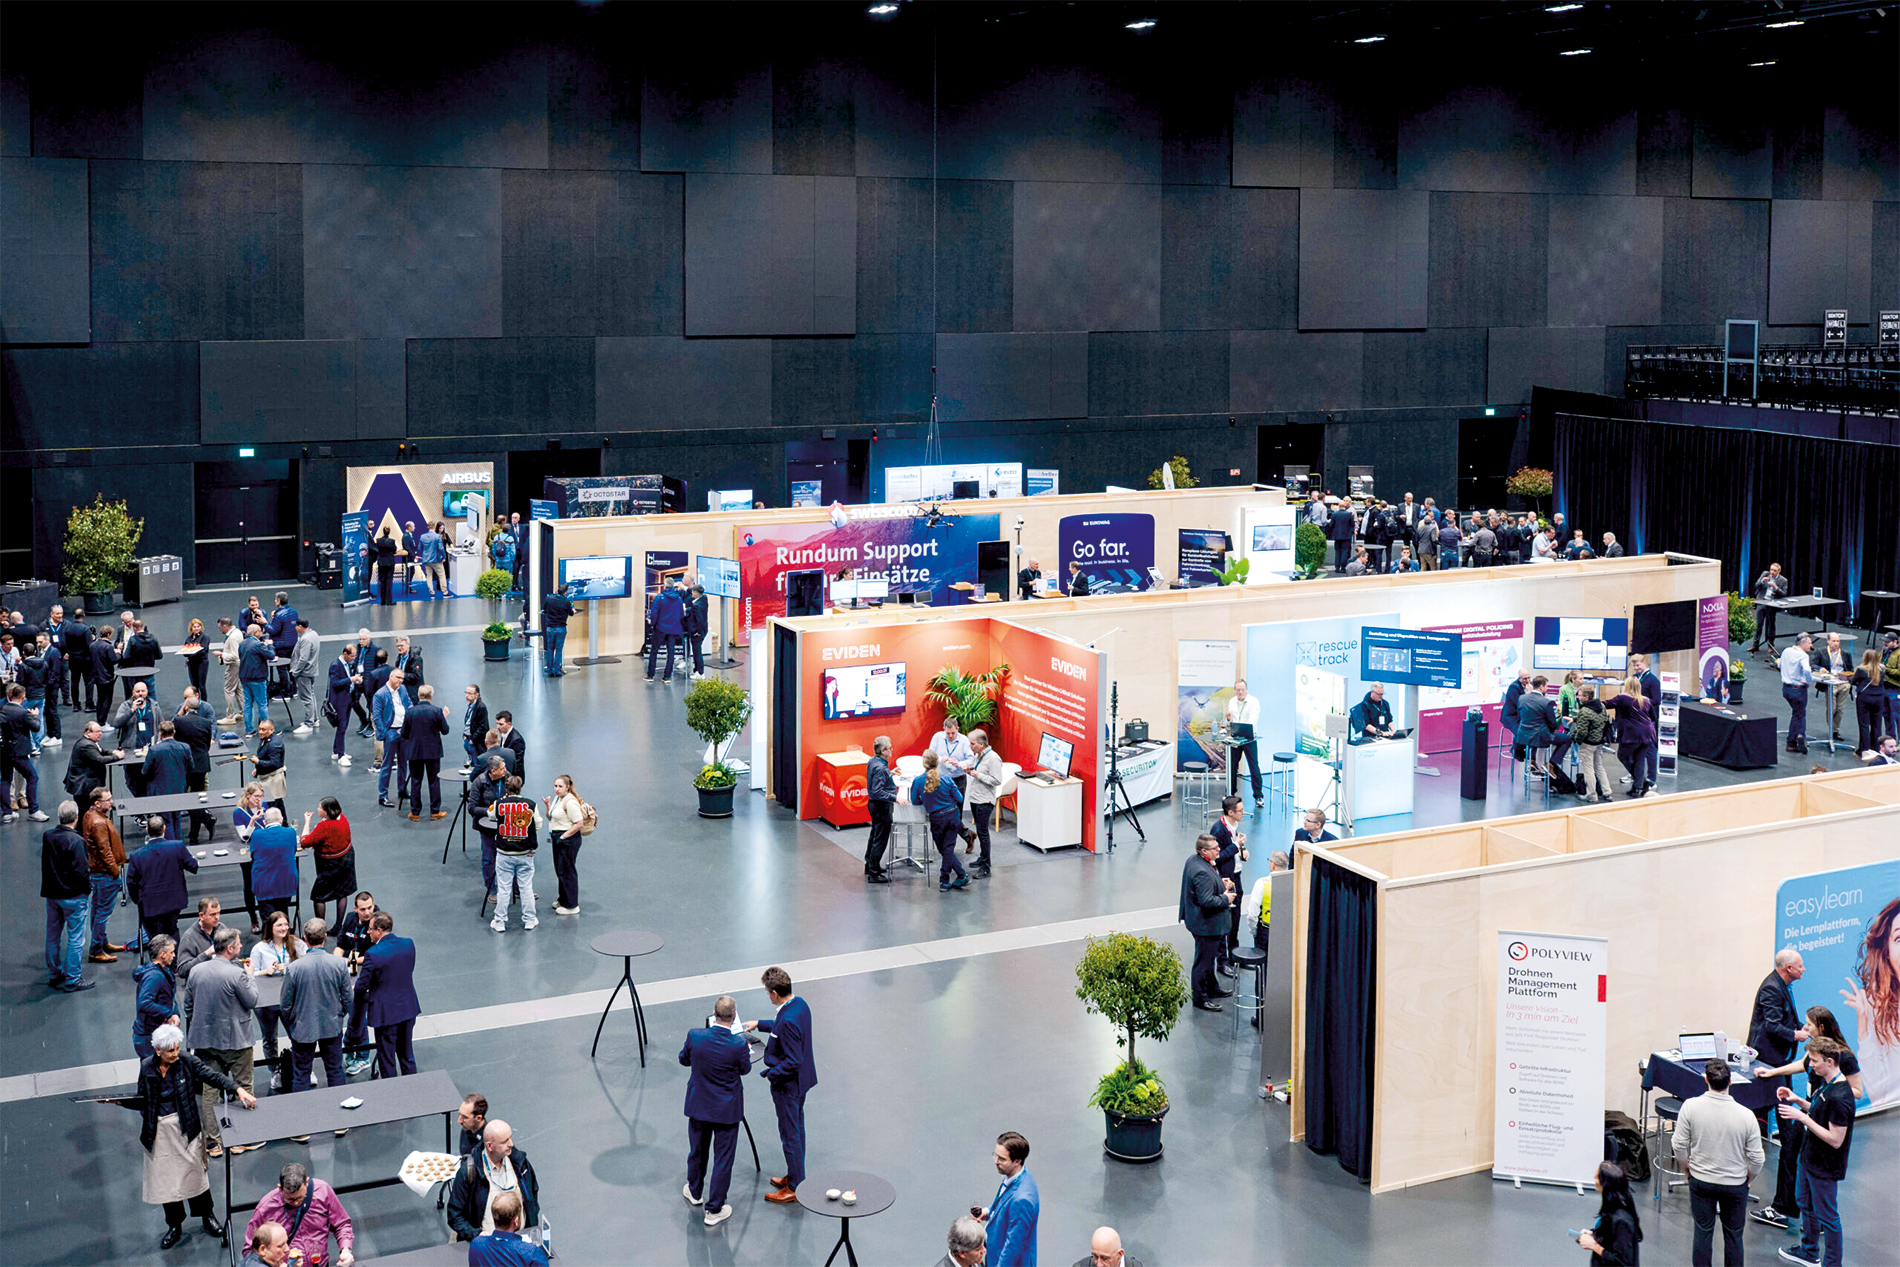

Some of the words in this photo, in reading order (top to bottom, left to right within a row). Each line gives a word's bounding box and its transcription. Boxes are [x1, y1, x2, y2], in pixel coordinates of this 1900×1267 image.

[441, 472, 491, 484] AIRBUS
[850, 503, 918, 519] swisscom
[776, 543, 857, 565] Rundum
[864, 539, 938, 564] Support
[1073, 540, 1095, 558] Go
[1099, 538, 1129, 556] far.
[854, 565, 929, 584] Einsätze
[1703, 603, 1724, 613] NOKIA
[744, 597, 752, 639] swisscom
[822, 644, 880, 660] EVIDEN
[1319, 640, 1357, 652] rescue
[1318, 652, 1348, 666] track
[1051, 657, 1086, 681] EVIDEN
[1122, 759, 1157, 777] SECURITON
[841, 789, 868, 798] EVIDE
[499, 803, 529, 815] CHAOS
[1786, 885, 1862, 919] easylearn
[1785, 927, 1799, 939] Die
[1801, 918, 1861, 935] Lernplattform,
[1785, 941, 1798, 951] die
[1799, 933, 1844, 951] begeistert!
[1532, 948, 1592, 961] POLYVIEW
[1508, 967, 1553, 978] Drohnen
[1508, 977, 1577, 990] Management
[1508, 987, 1557, 998] Plattform
[1506, 1003, 1533, 1011] Unsere
[1536, 1005, 1558, 1013] Vision
[1561, 1015, 1579, 1024] Ziel
[1540, 1066, 1571, 1074] Infrastruktur
